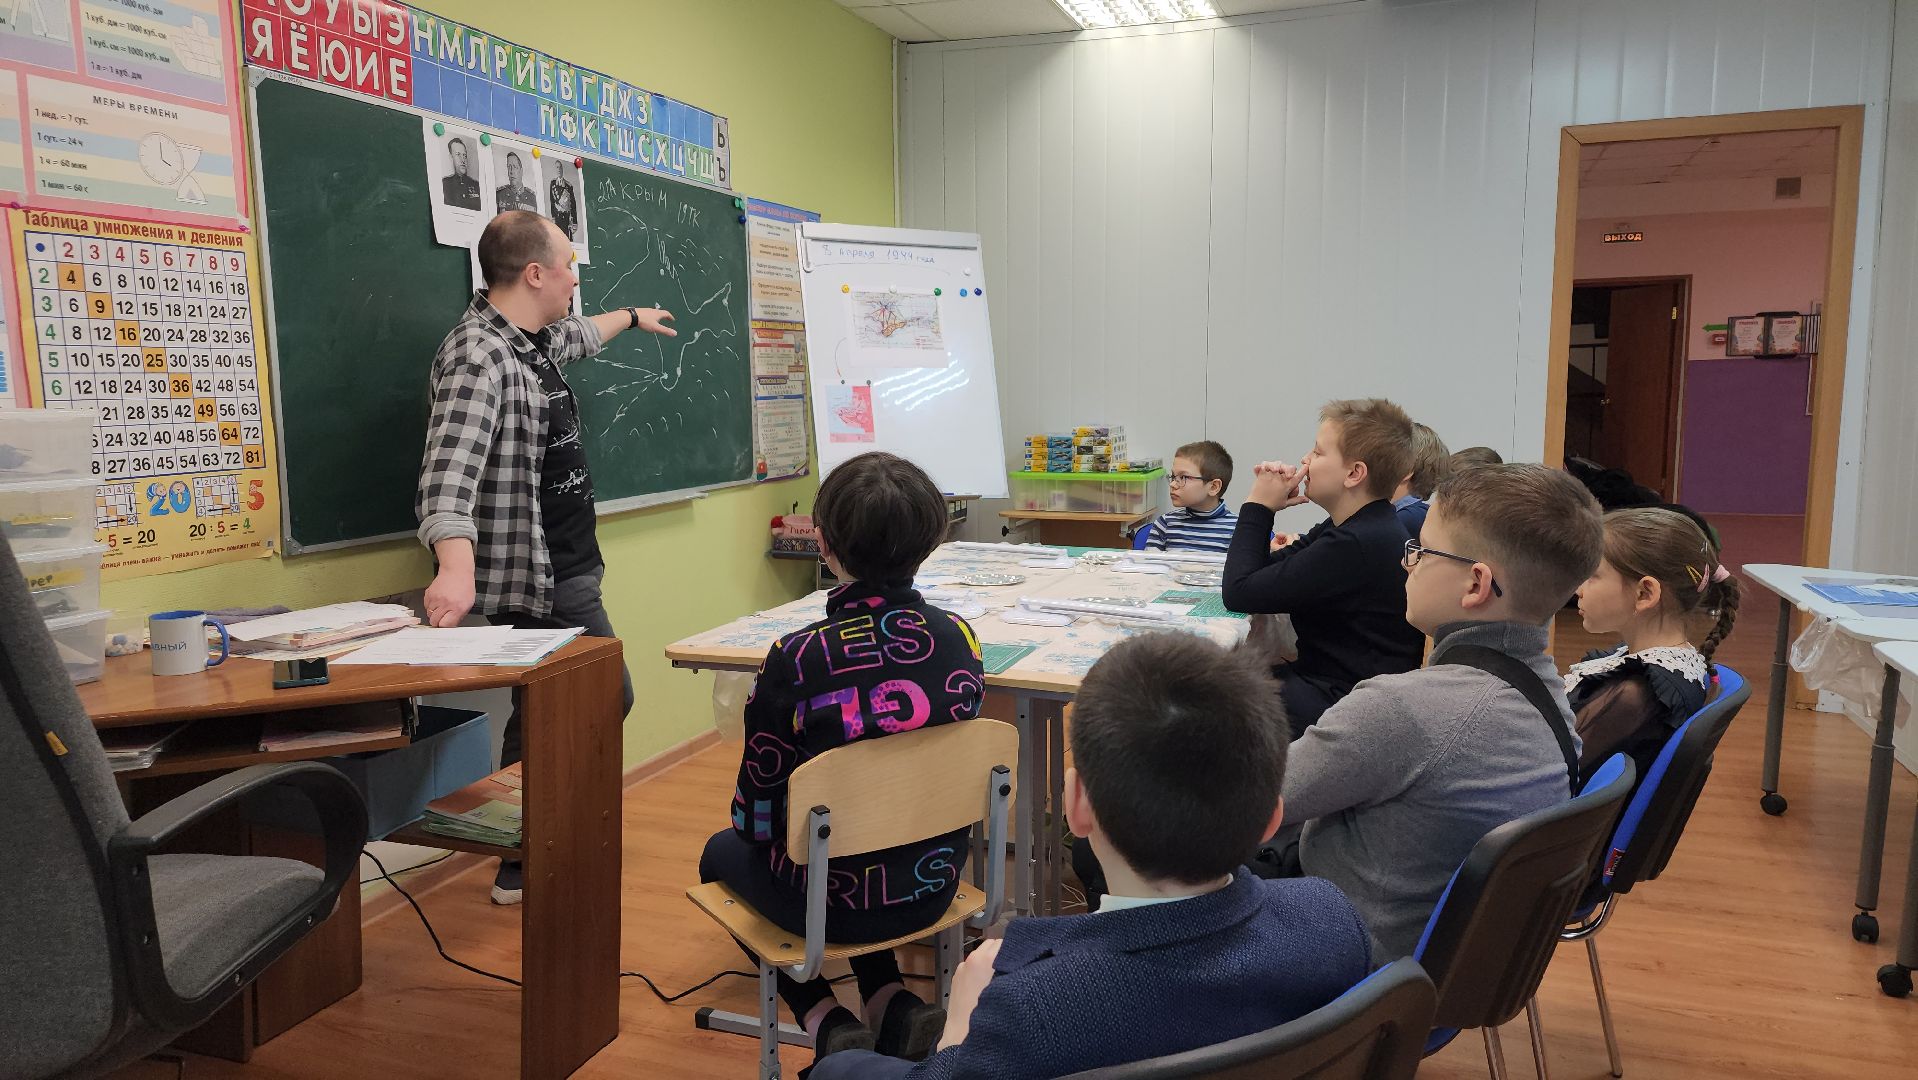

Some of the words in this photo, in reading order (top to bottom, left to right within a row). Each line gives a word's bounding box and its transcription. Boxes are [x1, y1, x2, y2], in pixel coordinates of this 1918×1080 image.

[252, 17, 274, 62] Я
[290, 21, 310, 72] Ё
[319, 36, 350, 82] Ю
[355, 47, 379, 90] И
[389, 57, 407, 97] Е
[412, 14, 434, 57] Н
[439, 25, 464, 66] М
[467, 35, 487, 73] Л
[494, 44, 508, 79] Р
[515, 51, 536, 90] Й
[539, 60, 553, 94] Б
[560, 69, 573, 100] В
[582, 76, 596, 105] Г
[600, 81, 616, 119] Д
[617, 88, 632, 121] Ж
[636, 95, 648, 125] З
[92, 95, 125, 109] МЕРЫ
[129, 103, 178, 120] ВРЕМЕНИ
[541, 104, 555, 137] П
[560, 111, 577, 142] Ф
[582, 116, 596, 149] К
[603, 122, 615, 153] Т
[618, 126, 635, 159] Ш
[638, 133, 651, 164] С
[656, 138, 668, 167] Х
[672, 143, 685, 176] Ц
[687, 147, 697, 176] Ч
[700, 152, 715, 183] Щ
[24, 210, 88, 232] Таблица
[93, 220, 173, 240] умножения
[179, 231, 186, 242] и
[191, 231, 243, 247] деления
[1604, 233, 1642, 242] ВЫХОД
[63, 242, 75, 259] 2
[90, 245, 100, 260] 3
[115, 246, 125, 262] 4
[140, 249, 149, 264] 5
[163, 252, 173, 266] 6
[186, 254, 195, 268] 7
[209, 256, 218, 270] 8
[230, 257, 240, 271] 9
[39, 268, 50, 284] 2
[66, 270, 76, 284] 4
[93, 272, 102, 286] 6
[118, 274, 127, 288] 8
[139, 276, 155, 290] 10
[163, 278, 179, 291] 12
[186, 279, 201, 292] 14
[209, 281, 223, 294] 16
[231, 282, 245, 295] 18
[42, 296, 52, 312] 3
[69, 298, 79, 312] 6
[95, 300, 105, 314] 9
[116, 301, 134, 315] 12
[142, 302, 158, 316] 15
[165, 303, 182, 317] 18
[188, 305, 202, 317] 21
[209, 306, 226, 319] 24
[232, 307, 247, 320] 27
[45, 325, 56, 340] 4
[72, 326, 81, 340] 8
[94, 327, 112, 341] 12
[119, 327, 136, 341] 16
[142, 328, 161, 341] 20
[167, 329, 184, 342] 24
[190, 329, 207, 343] 28
[212, 330, 229, 343] 32
[234, 331, 250, 343] 36
[49, 352, 59, 367] 5
[71, 353, 89, 367] 10
[98, 353, 115, 367] 15
[121, 354, 140, 367] 20
[146, 354, 163, 367] 25
[170, 354, 187, 367] 30
[192, 355, 209, 367] 35
[214, 355, 231, 367] 40
[236, 356, 252, 368] 45
[51, 380, 62, 395] 6
[75, 380, 92, 394] 12
[100, 380, 117, 394] 18
[124, 380, 142, 393] 24
[149, 380, 166, 393] 30
[173, 380, 189, 392] 36
[195, 380, 211, 392] 42
[217, 380, 234, 392] 48
[239, 379, 255, 392] 54
[102, 407, 119, 420] 21
[127, 406, 145, 419] 28
[151, 405, 169, 418] 35
[174, 404, 192, 417] 42
[197, 404, 214, 417] 49
[219, 403, 236, 416] 56
[241, 403, 258, 415] 63
[106, 433, 123, 446] 24
[130, 432, 148, 445] 32
[154, 431, 172, 444] 40
[177, 430, 194, 442] 48
[199, 428, 217, 441] 56
[221, 428, 238, 440] 64
[243, 427, 259, 439] 72
[107, 460, 126, 474] 27
[132, 457, 151, 471] 36
[156, 456, 175, 469] 45
[179, 454, 197, 468] 54
[202, 453, 219, 466] 63
[224, 452, 240, 465] 72
[246, 451, 260, 463] 81
[146, 480, 191, 517] 20
[246, 479, 265, 511] 5
[108, 535, 117, 547] 5
[137, 529, 156, 544] 20
[189, 524, 206, 538] 20
[217, 521, 225, 533] 5
[775, 609, 935, 685] YES
